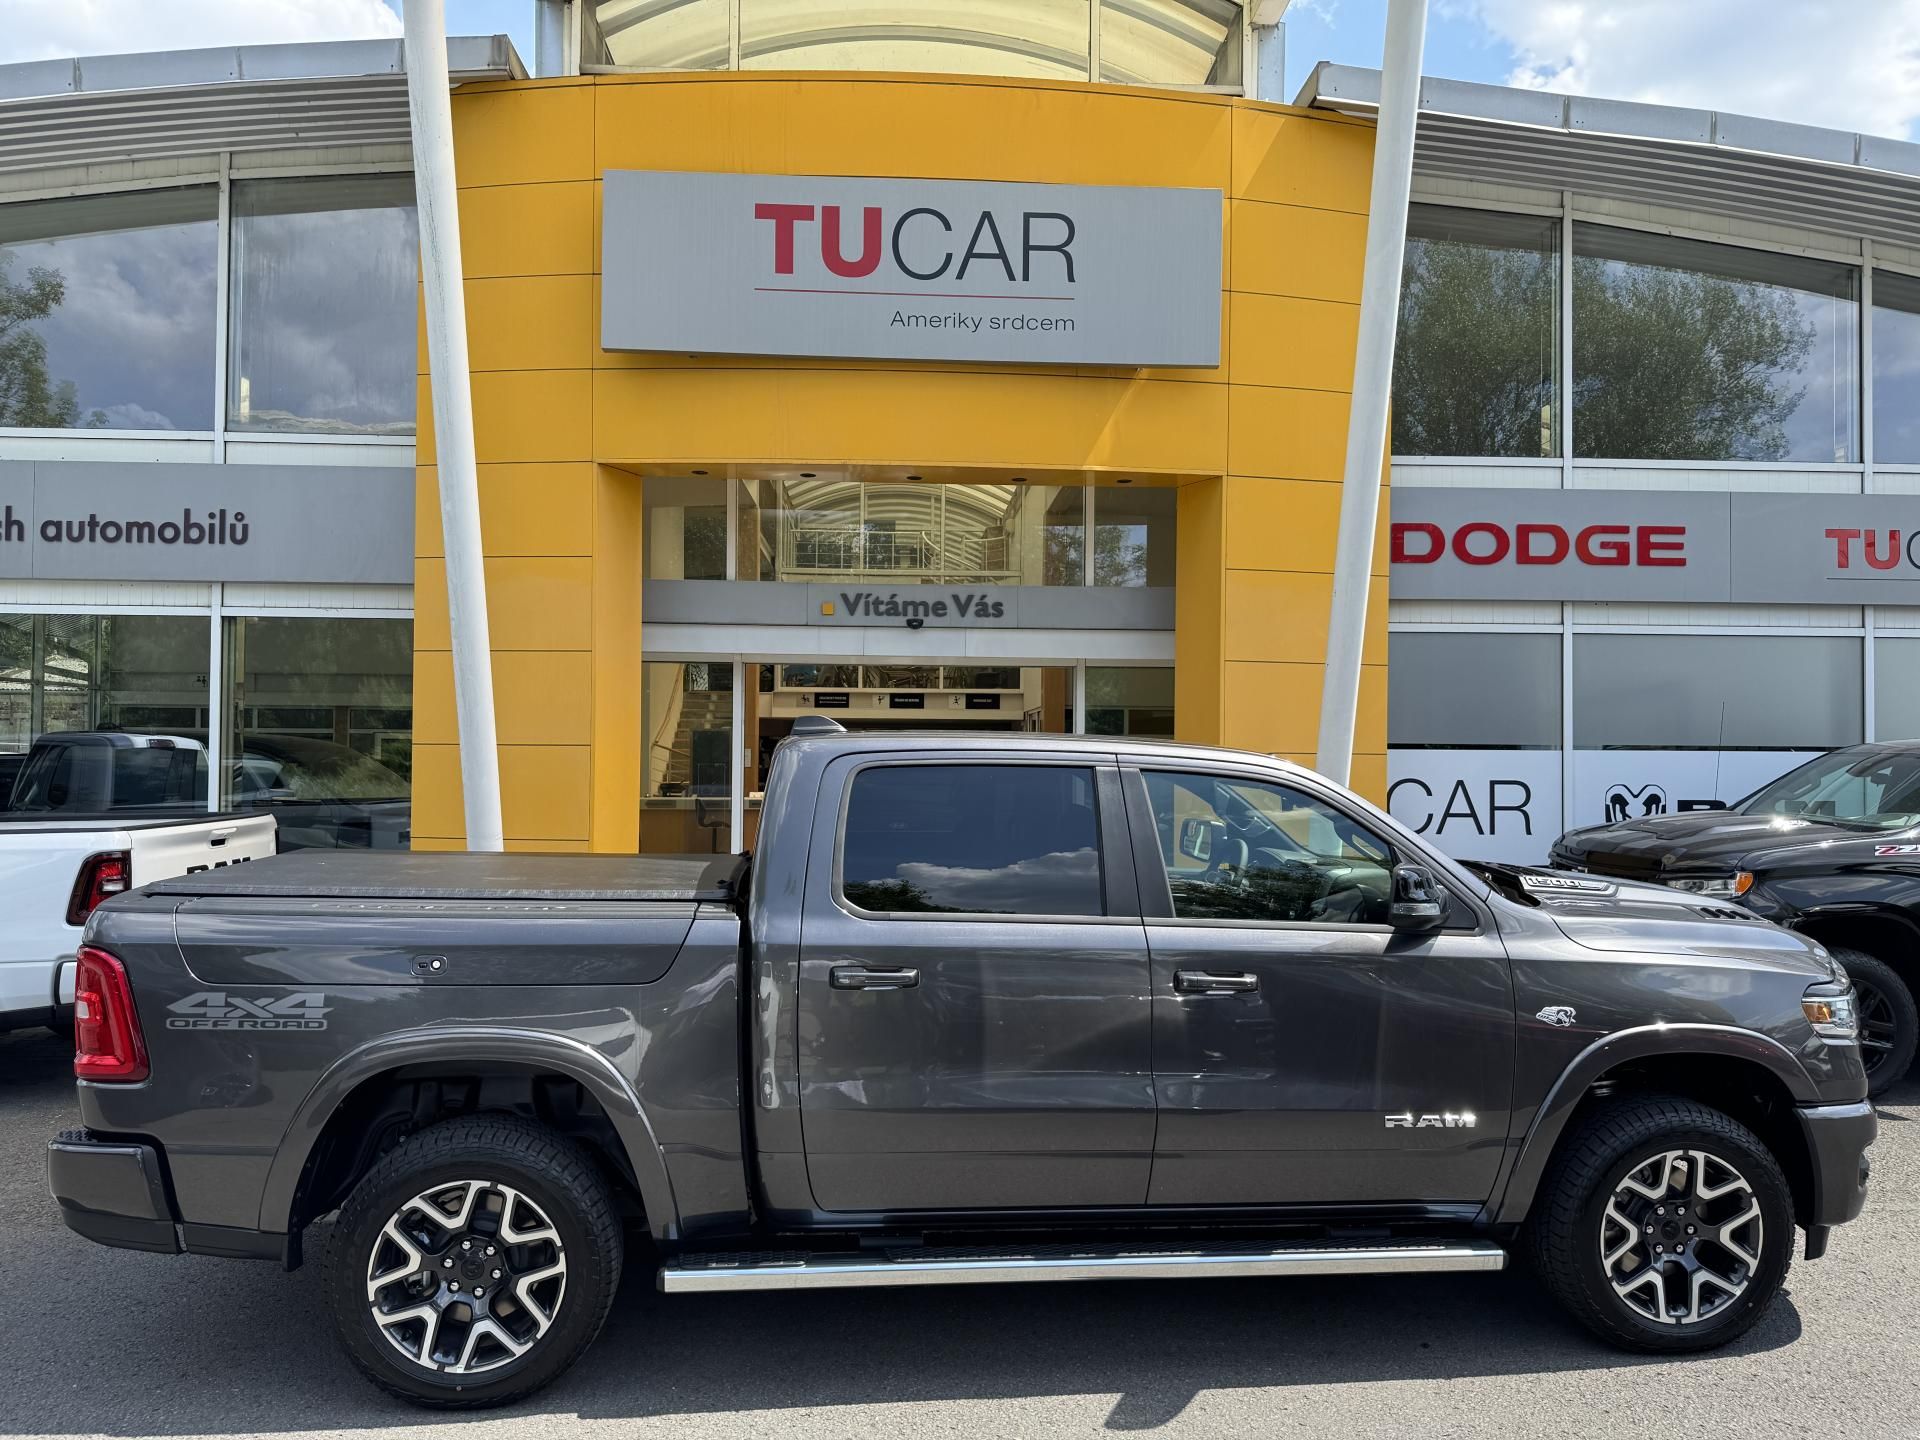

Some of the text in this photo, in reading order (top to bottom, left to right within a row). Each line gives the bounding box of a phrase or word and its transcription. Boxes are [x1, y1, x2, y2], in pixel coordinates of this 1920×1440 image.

[754, 203, 1077, 283] TUCAR
[890, 310, 1075, 333] Ameriky srdcem
[0, 505, 249, 545] h automobilů
[1391, 522, 1687, 566] DODGE
[840, 593, 1004, 618] Vítáme Vás
[169, 1019, 326, 1029] OFF ROAD
[1384, 1112, 1477, 1128] RAM
